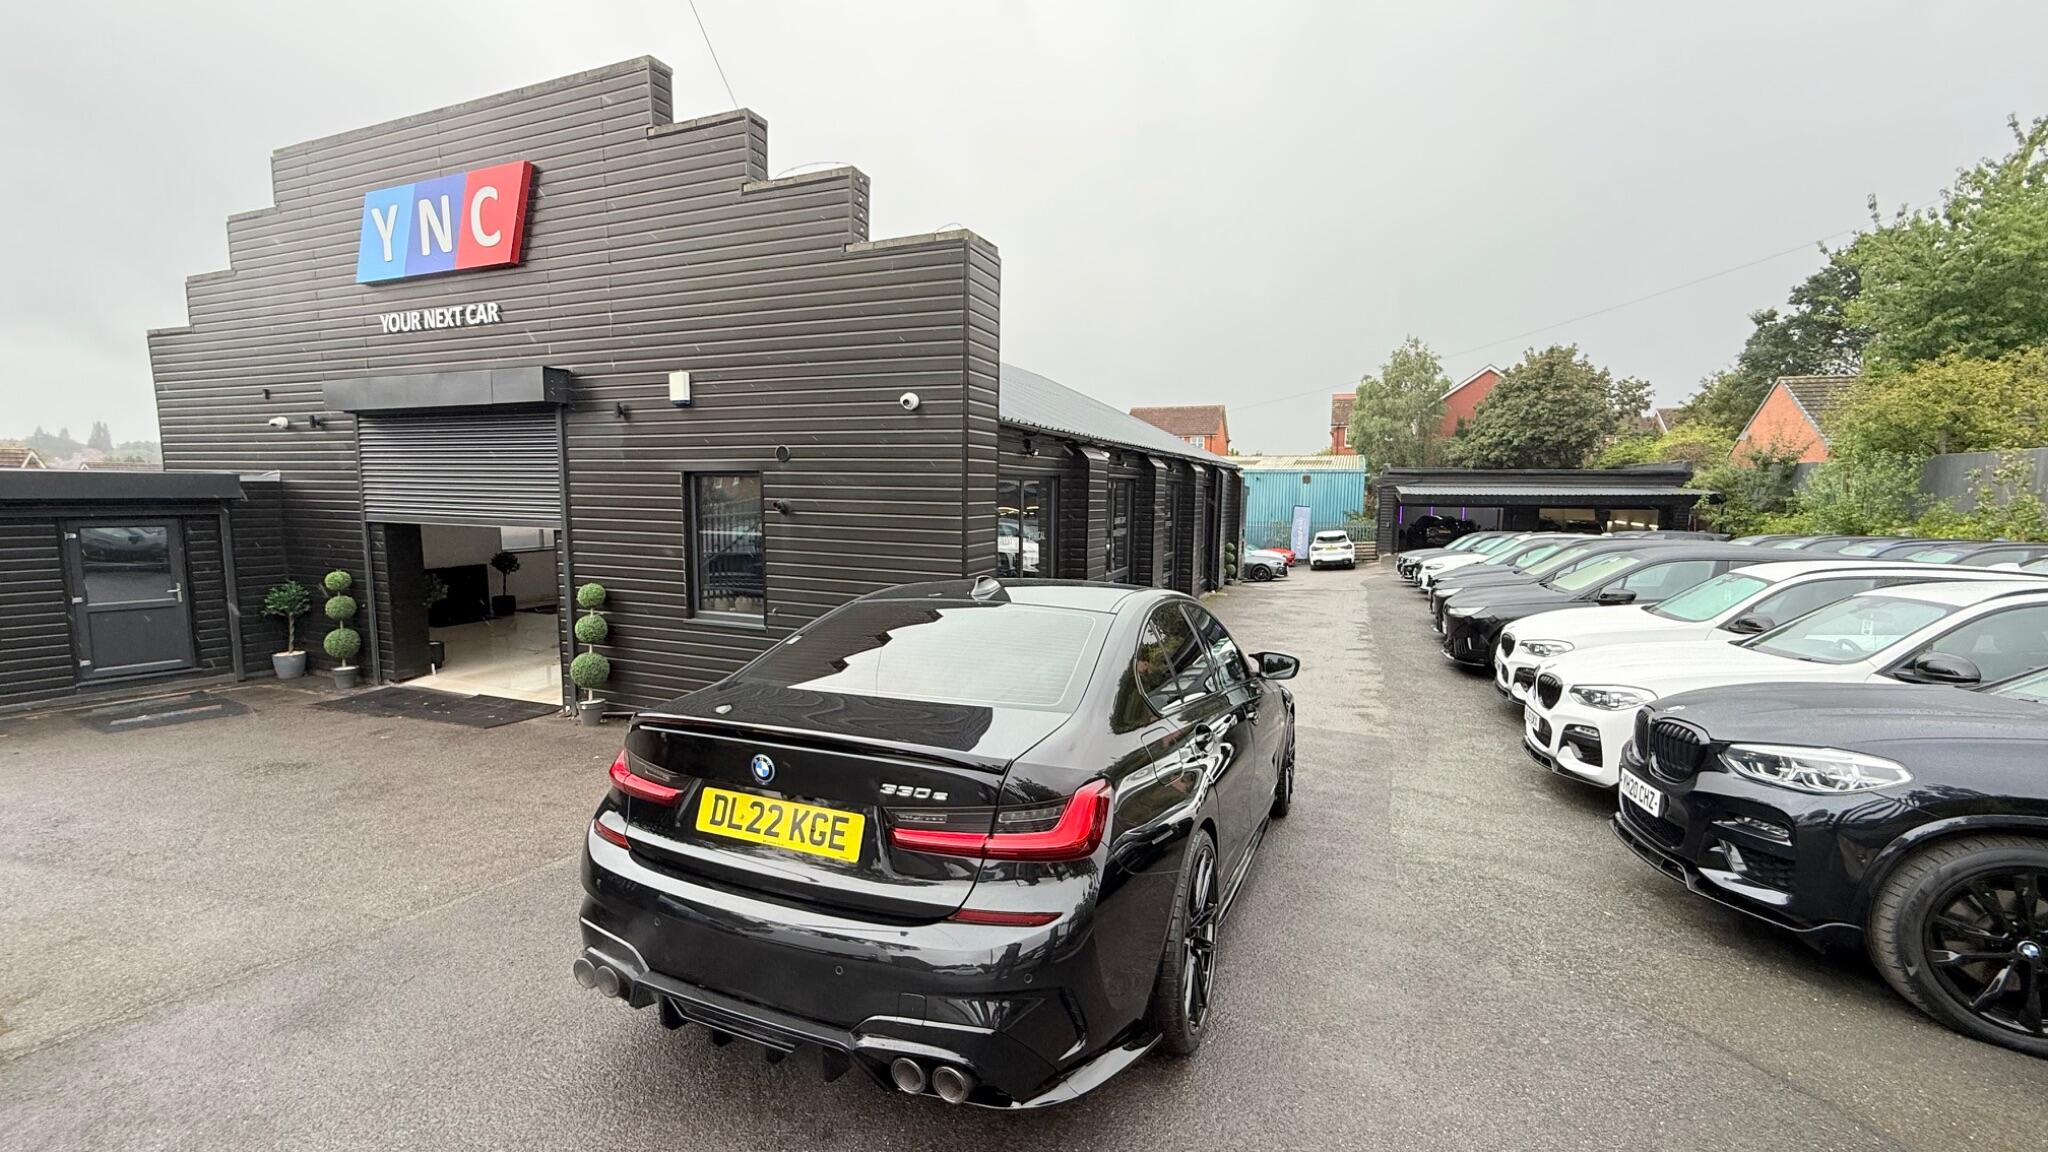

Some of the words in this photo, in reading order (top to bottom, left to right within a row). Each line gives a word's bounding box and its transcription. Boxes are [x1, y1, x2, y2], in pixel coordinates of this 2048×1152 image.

[371, 186, 501, 262] YNC
[380, 311, 422, 333] YOUR
[423, 306, 463, 329] NEXT
[465, 302, 500, 325] CAR
[1639, 785, 1656, 810] CHZ
[709, 794, 783, 838] DL22
[788, 808, 850, 851] KGE
